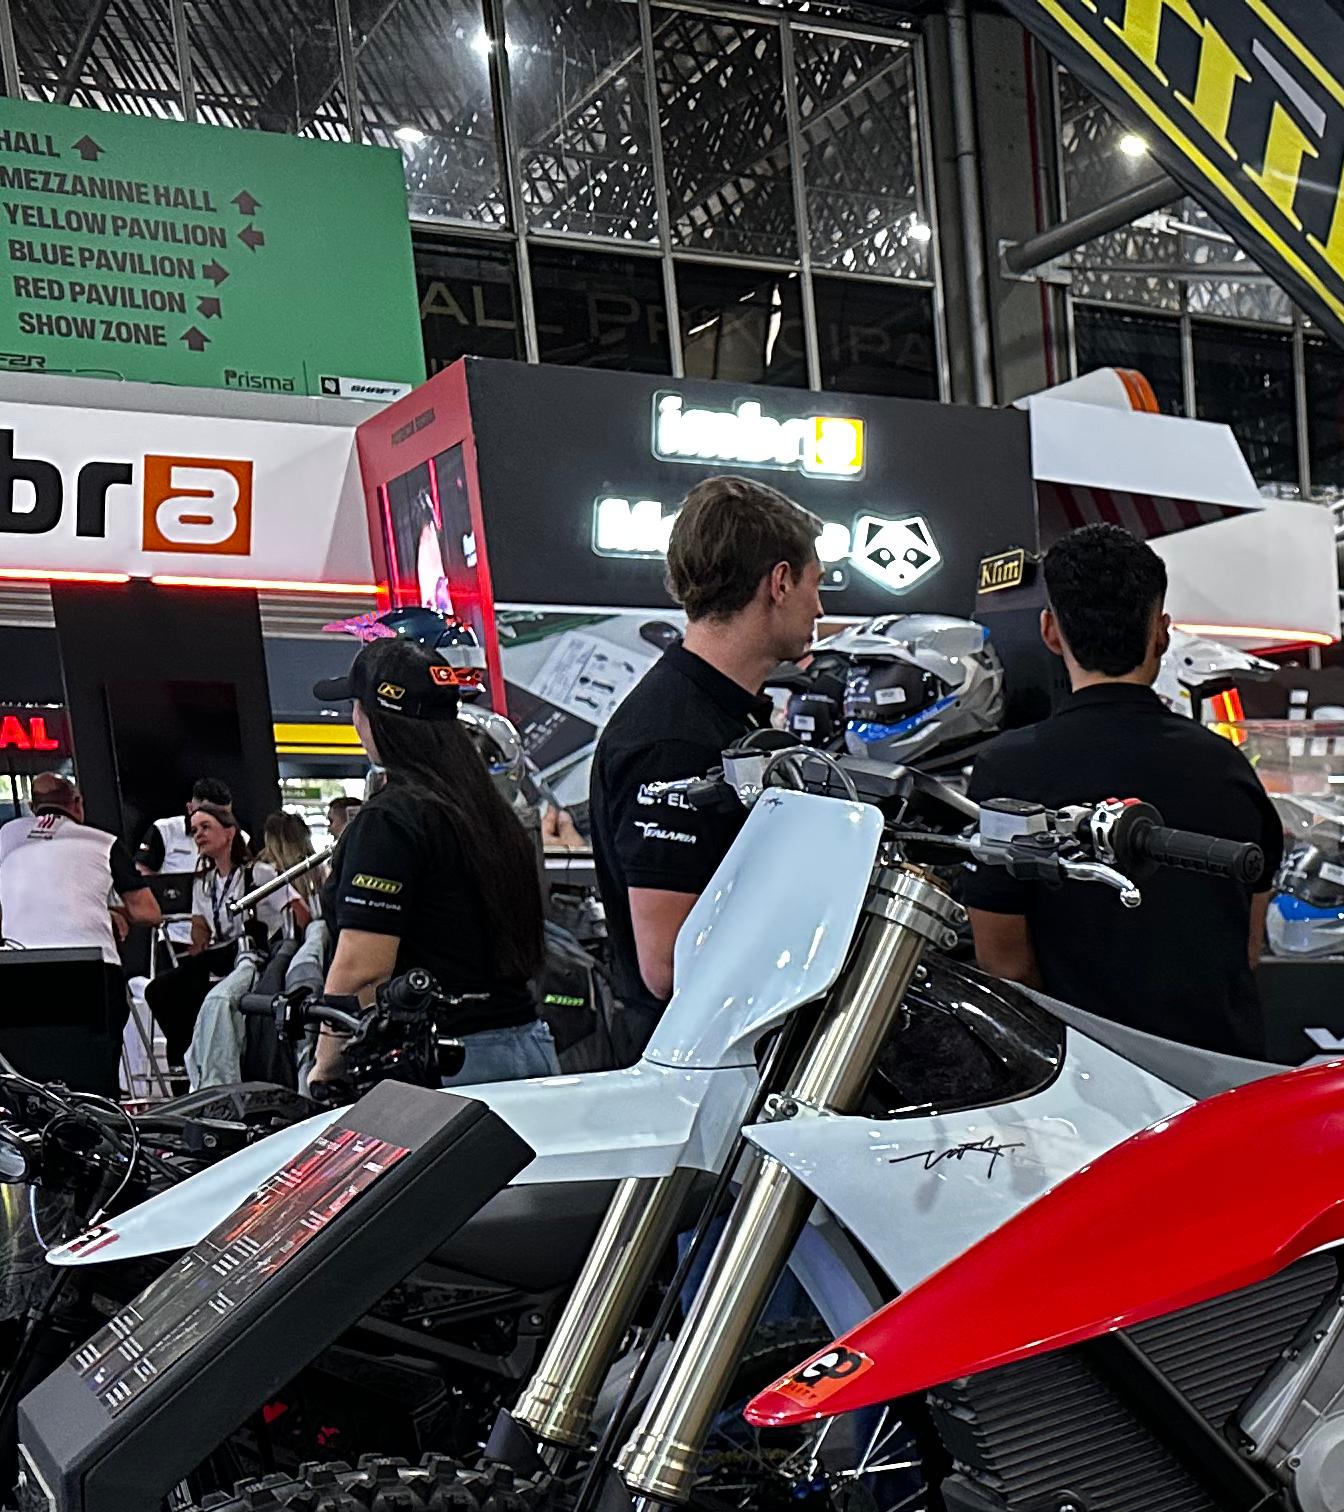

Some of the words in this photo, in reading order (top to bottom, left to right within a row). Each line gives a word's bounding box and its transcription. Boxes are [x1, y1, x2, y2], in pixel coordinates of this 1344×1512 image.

[0, 130, 61, 158] HALL
[0, 166, 150, 205] MEZZANINE
[153, 185, 218, 213] HALL
[5, 203, 106, 236] YELLOW
[112, 214, 227, 249] PAVILION
[8, 239, 74, 268] BLUE
[79, 246, 195, 280] PAVILION
[13, 275, 65, 302] RED
[69, 280, 187, 314] PAVILION
[18, 311, 96, 341] SHOW
[101, 319, 168, 347] ZONE
[224, 369, 295, 392] Prisma
